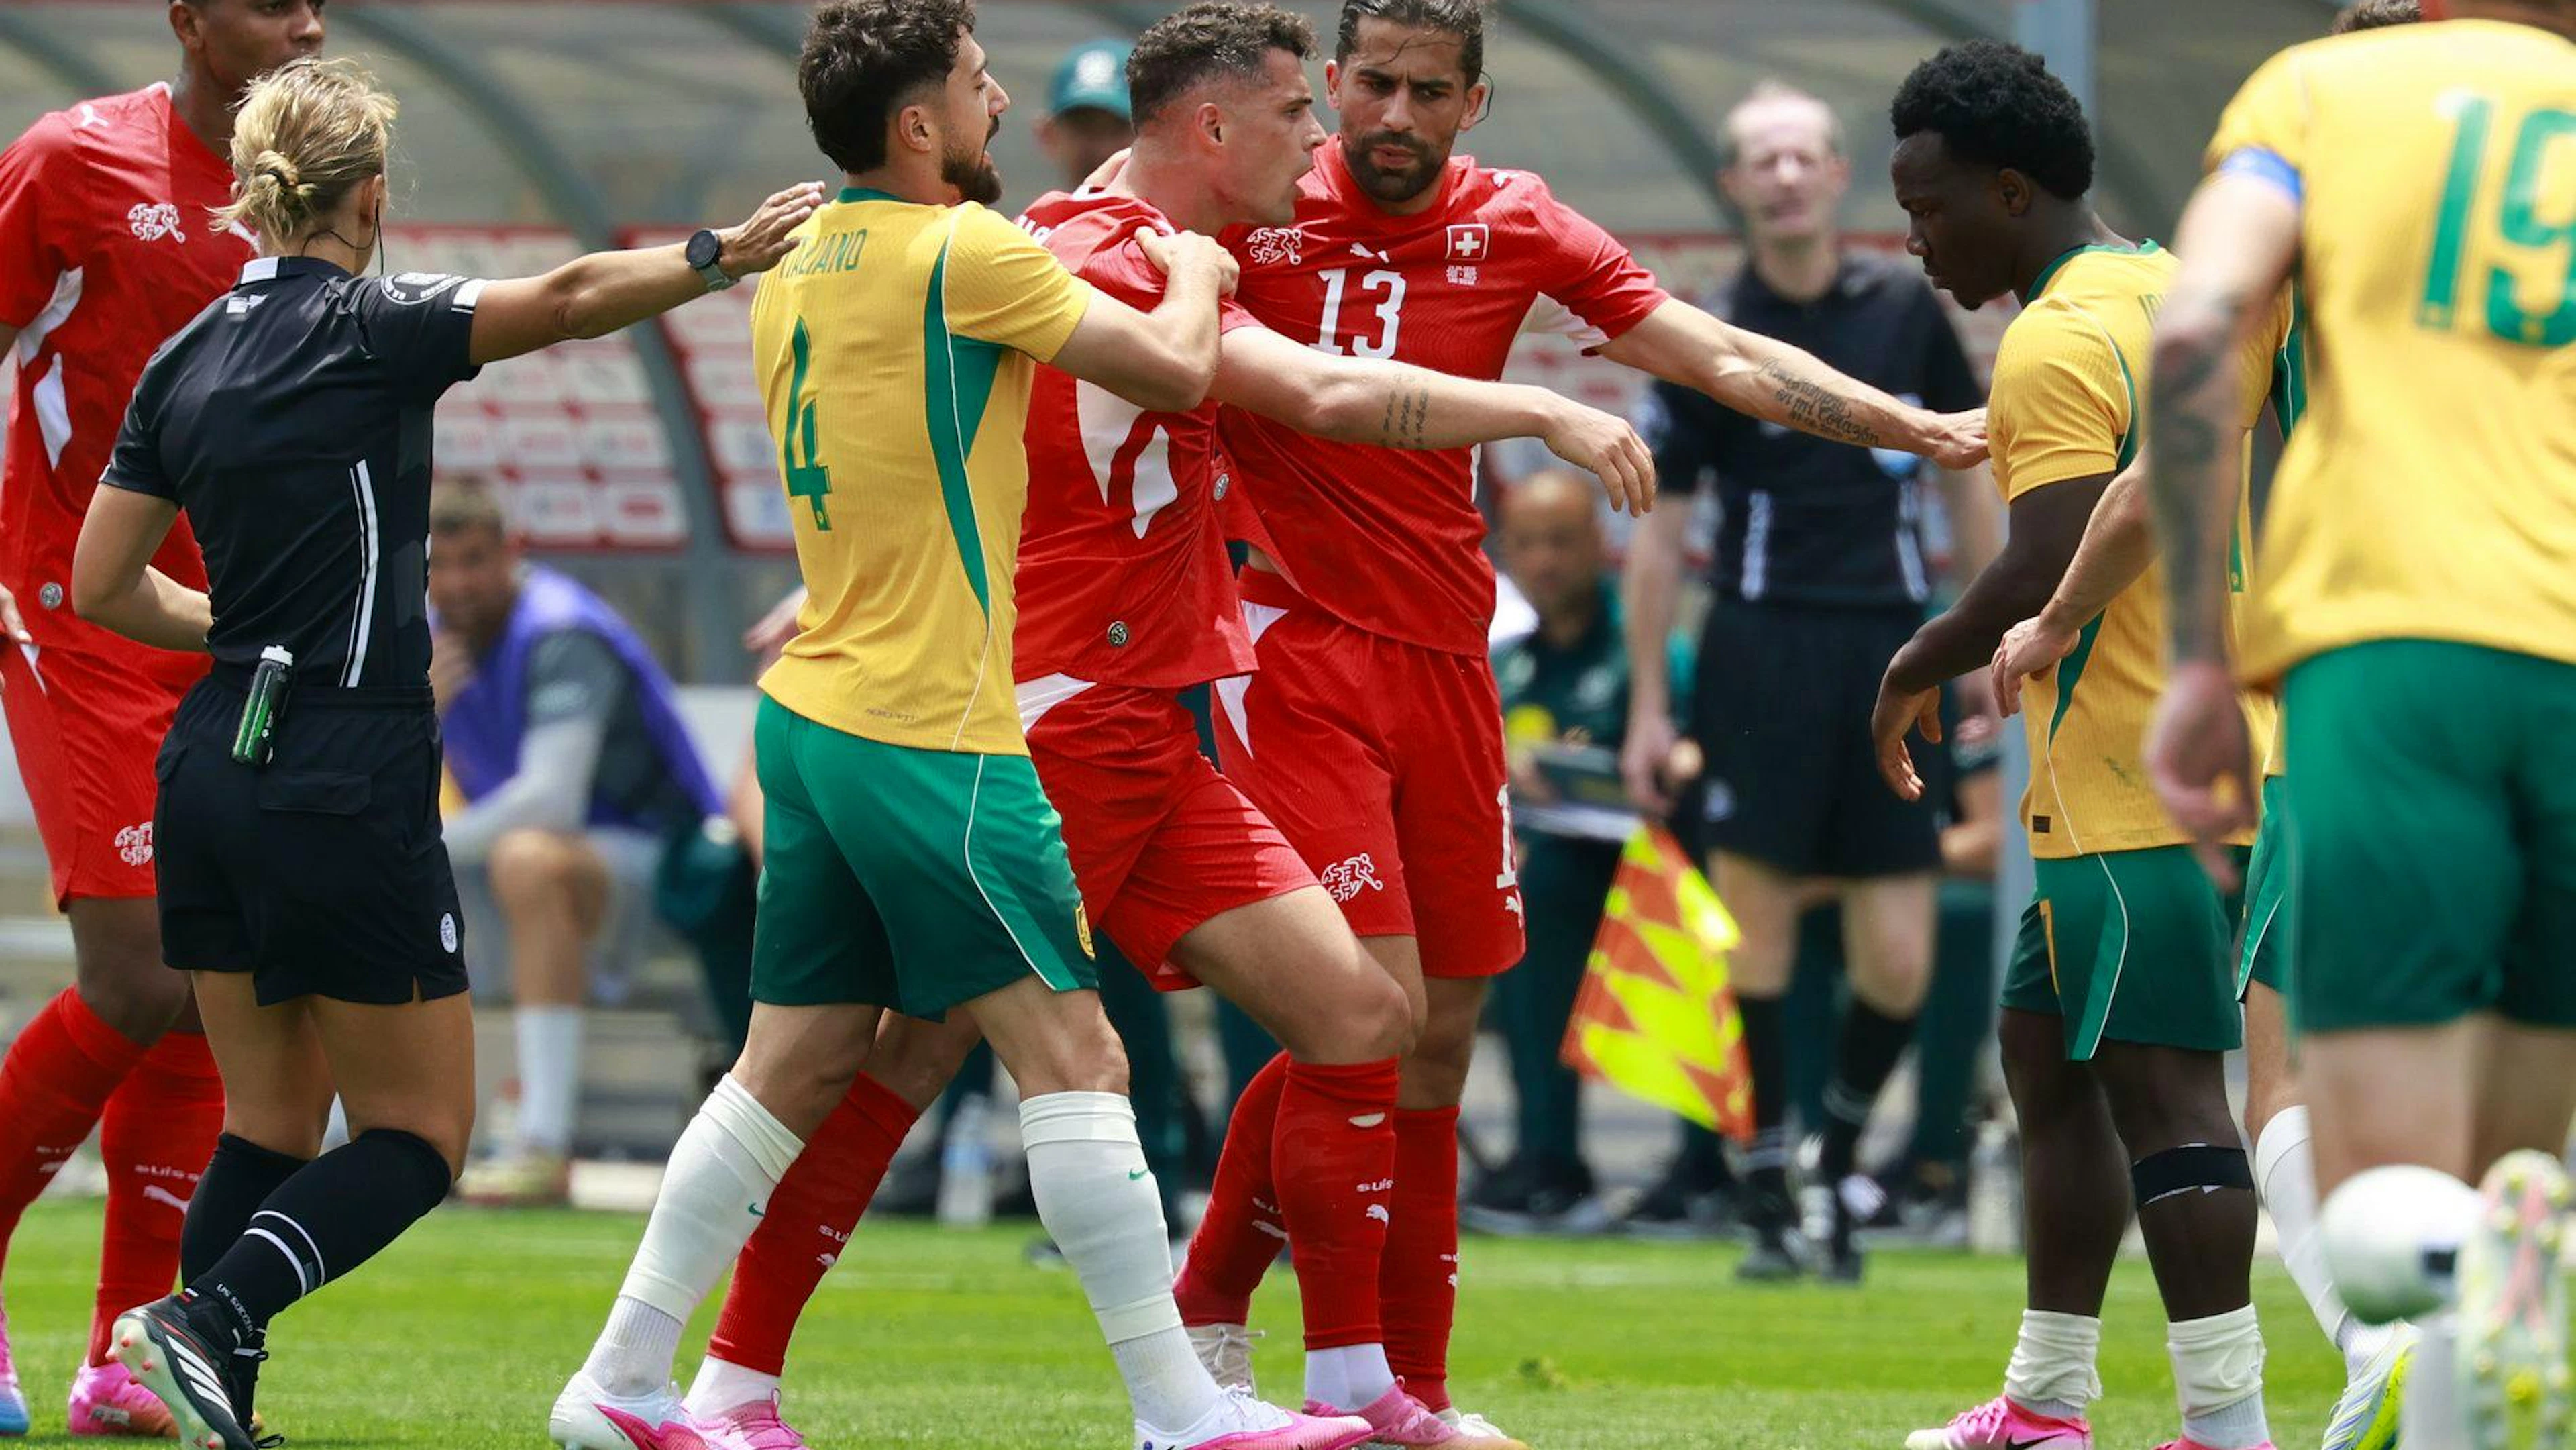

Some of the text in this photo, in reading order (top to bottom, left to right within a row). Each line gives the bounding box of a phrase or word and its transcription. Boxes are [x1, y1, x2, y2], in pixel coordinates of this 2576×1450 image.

[2418, 95, 2576, 349] 19
[1309, 268, 1407, 360] 13
[785, 315, 832, 531] 4
[1496, 784, 1517, 890] 1
